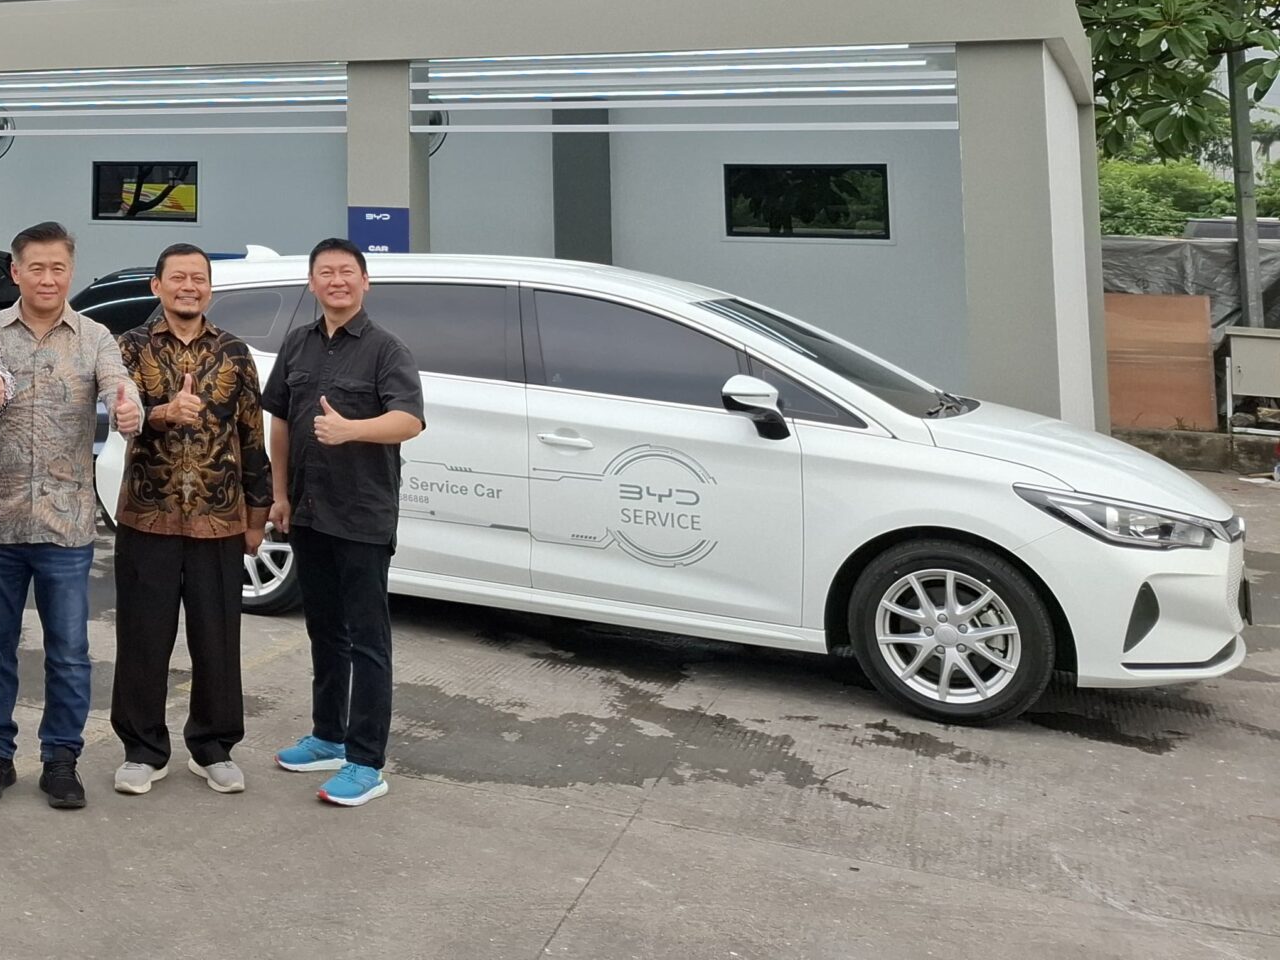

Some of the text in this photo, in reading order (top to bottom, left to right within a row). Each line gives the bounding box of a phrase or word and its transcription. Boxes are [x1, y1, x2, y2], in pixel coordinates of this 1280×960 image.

[409, 476, 468, 495] Service
[474, 483, 503, 499] Car
[619, 483, 700, 505] BYD
[620, 508, 701, 531] SERVICE
